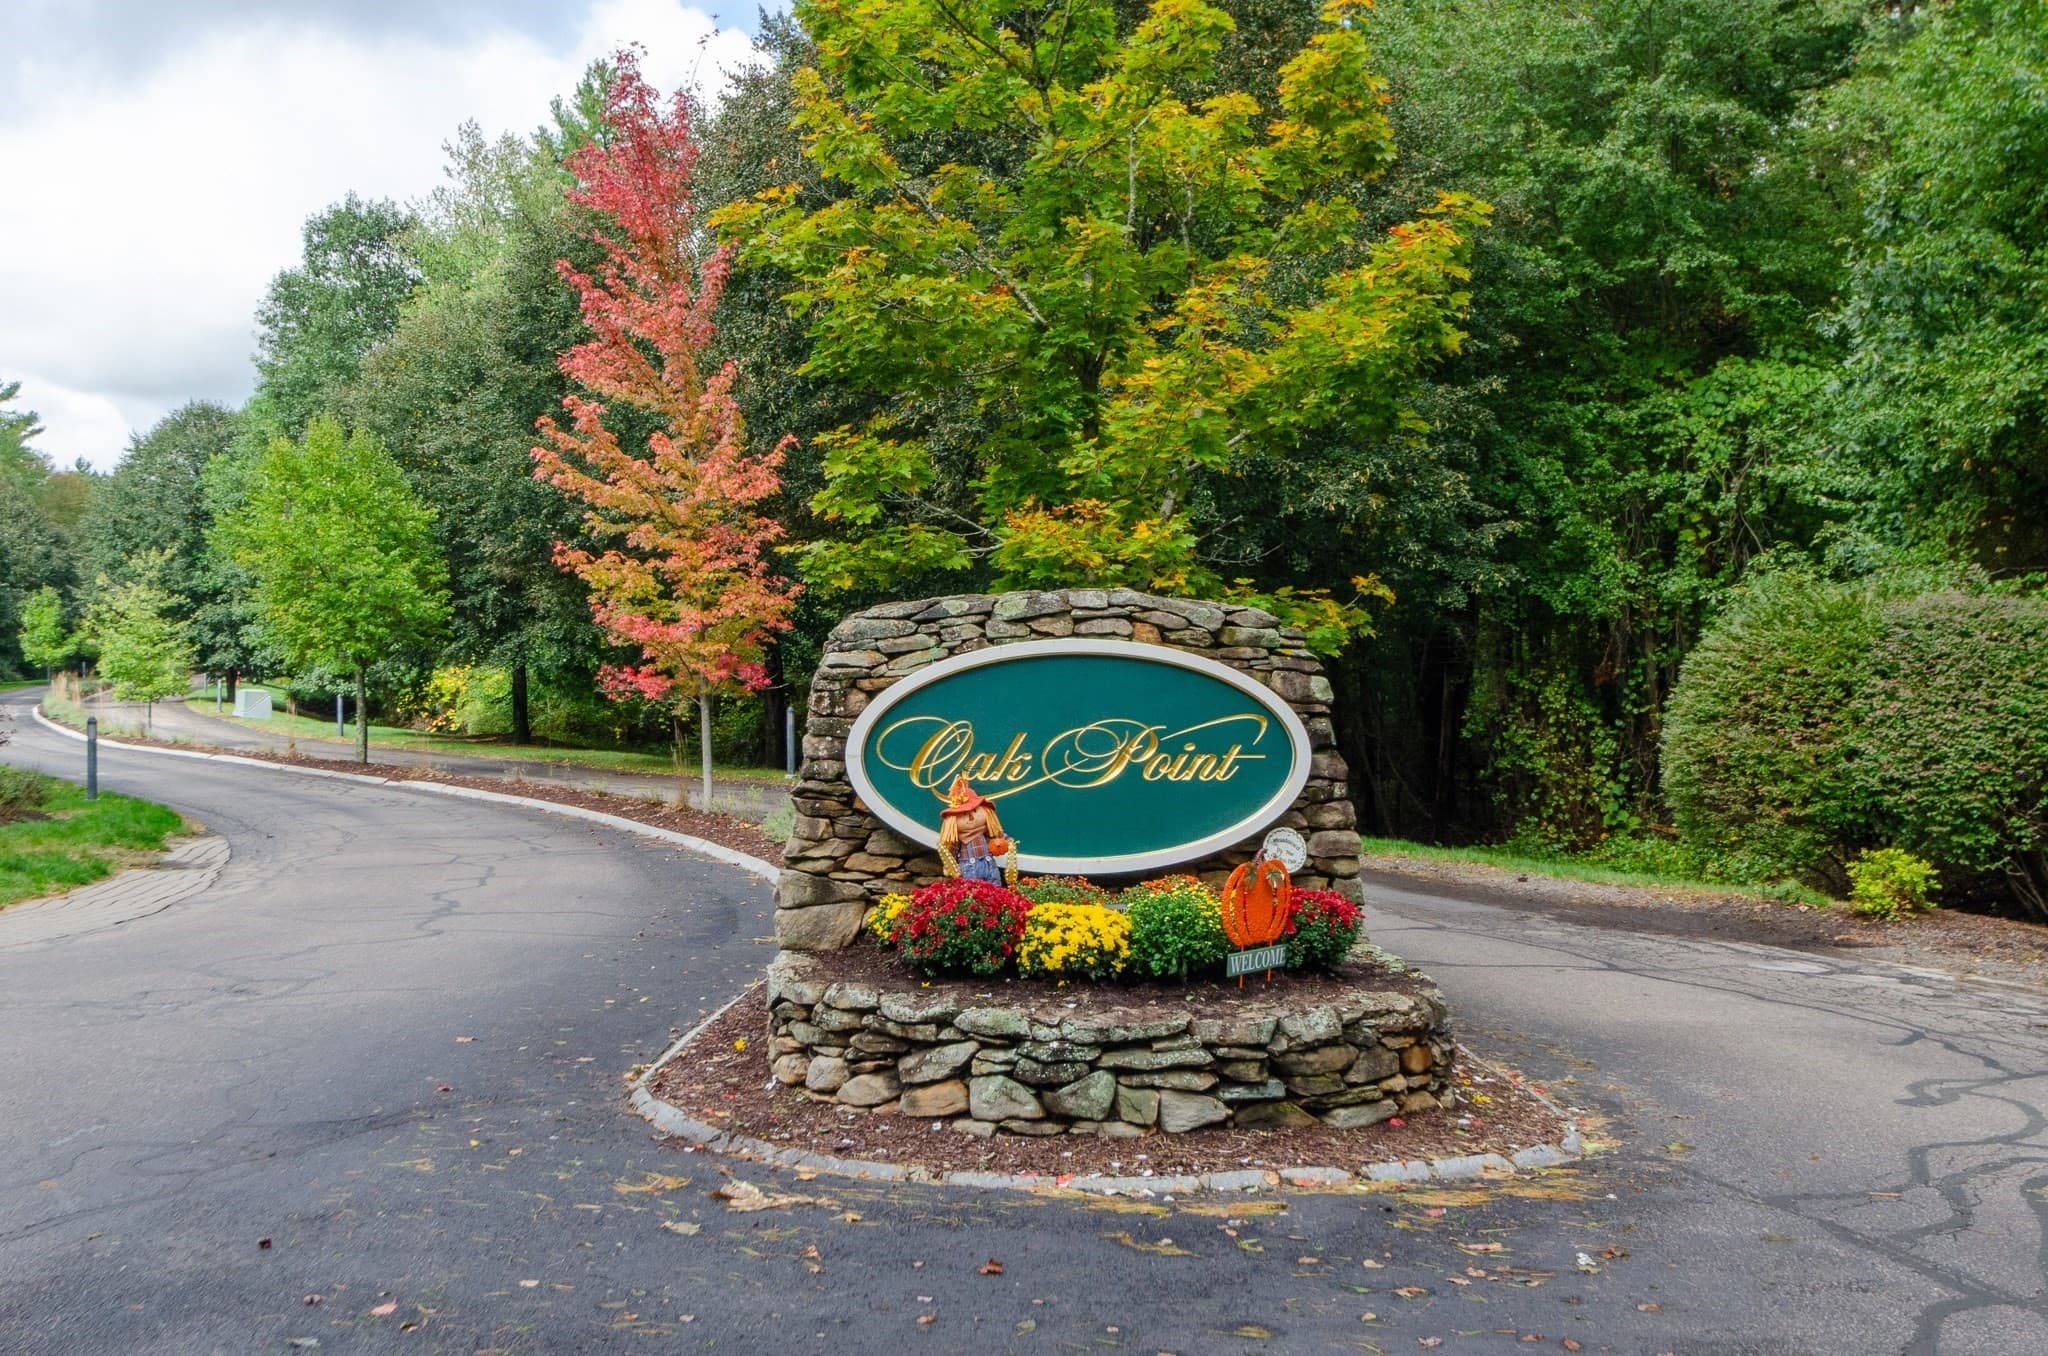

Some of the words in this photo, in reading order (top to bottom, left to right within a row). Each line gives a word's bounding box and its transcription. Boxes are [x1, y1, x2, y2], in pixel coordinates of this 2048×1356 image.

[876, 716, 1032, 802] Oak
[1042, 714, 1267, 788] Point
[1231, 947, 1286, 973] WELCOME
